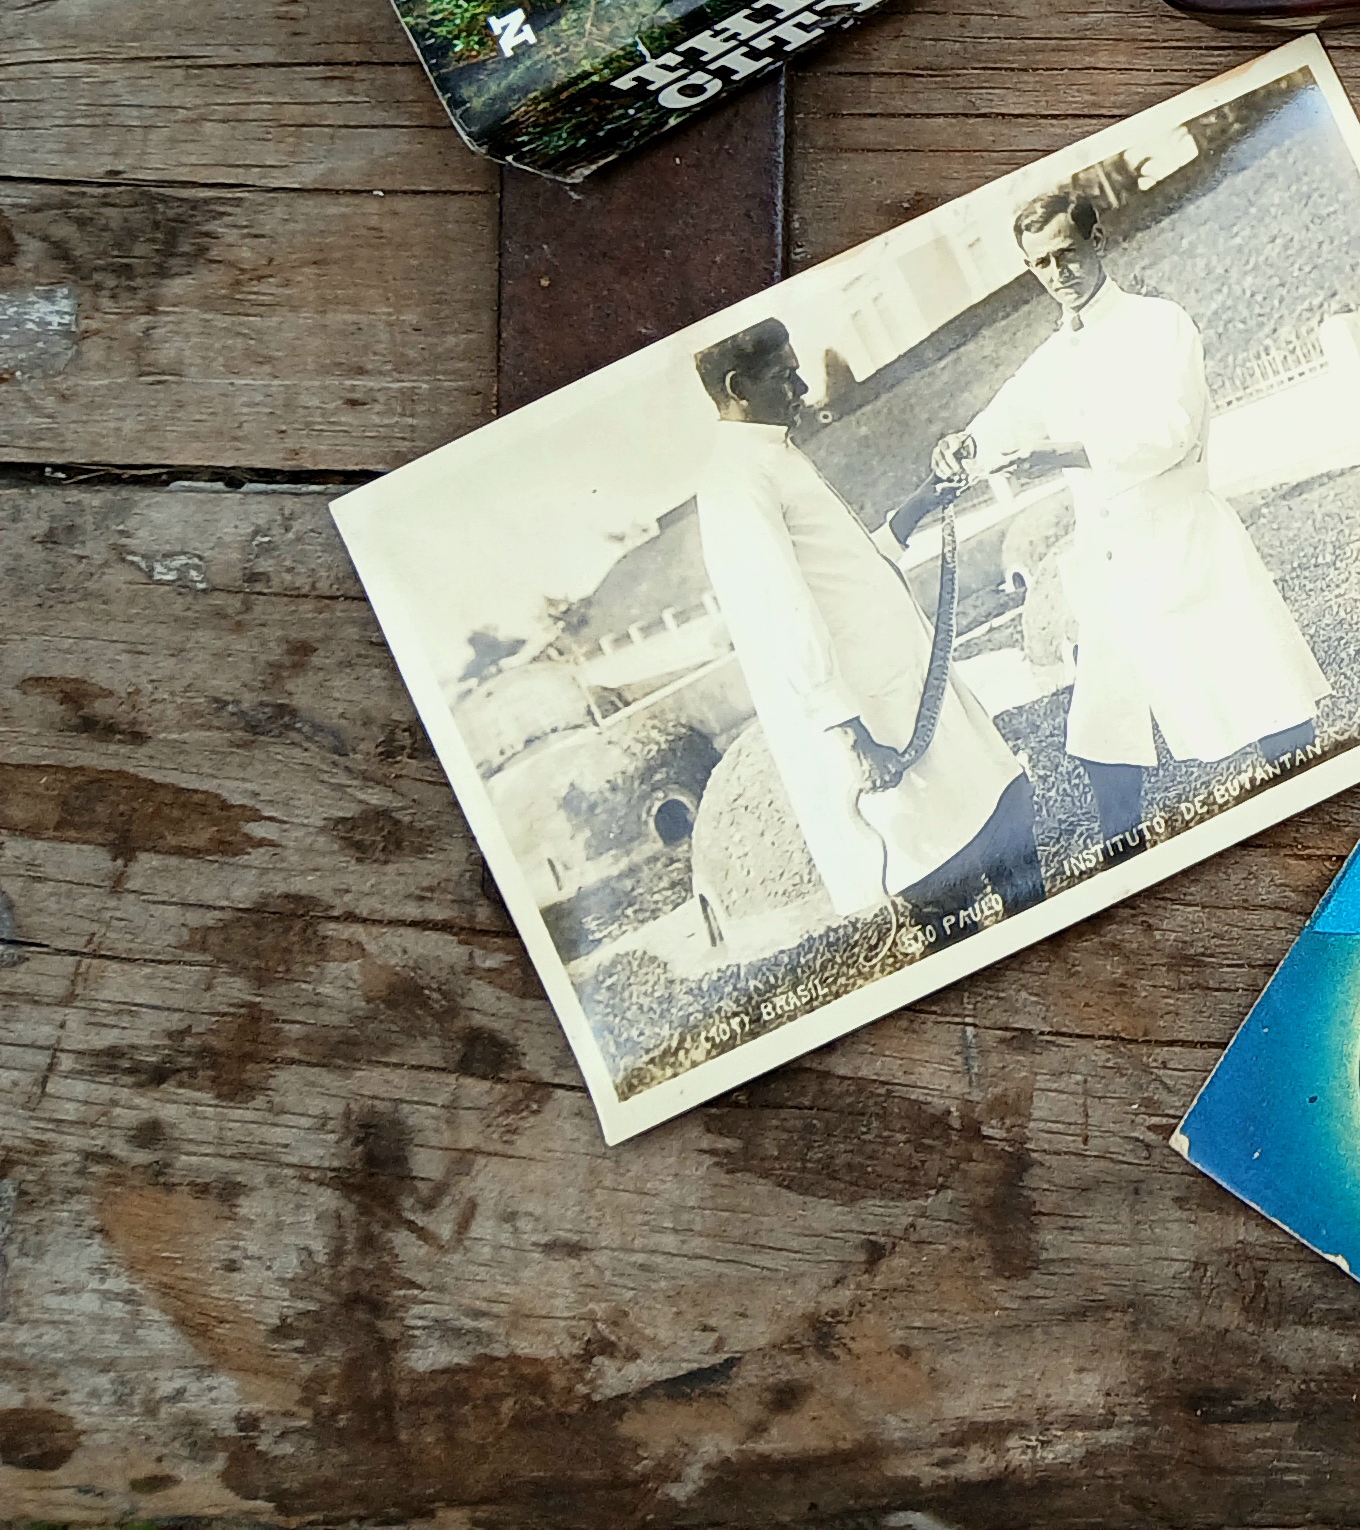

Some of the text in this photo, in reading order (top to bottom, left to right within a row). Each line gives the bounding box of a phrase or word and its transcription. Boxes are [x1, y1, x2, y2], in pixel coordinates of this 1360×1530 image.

[1063, 738, 1324, 875] INSTITUTO DE BUTANTAN
